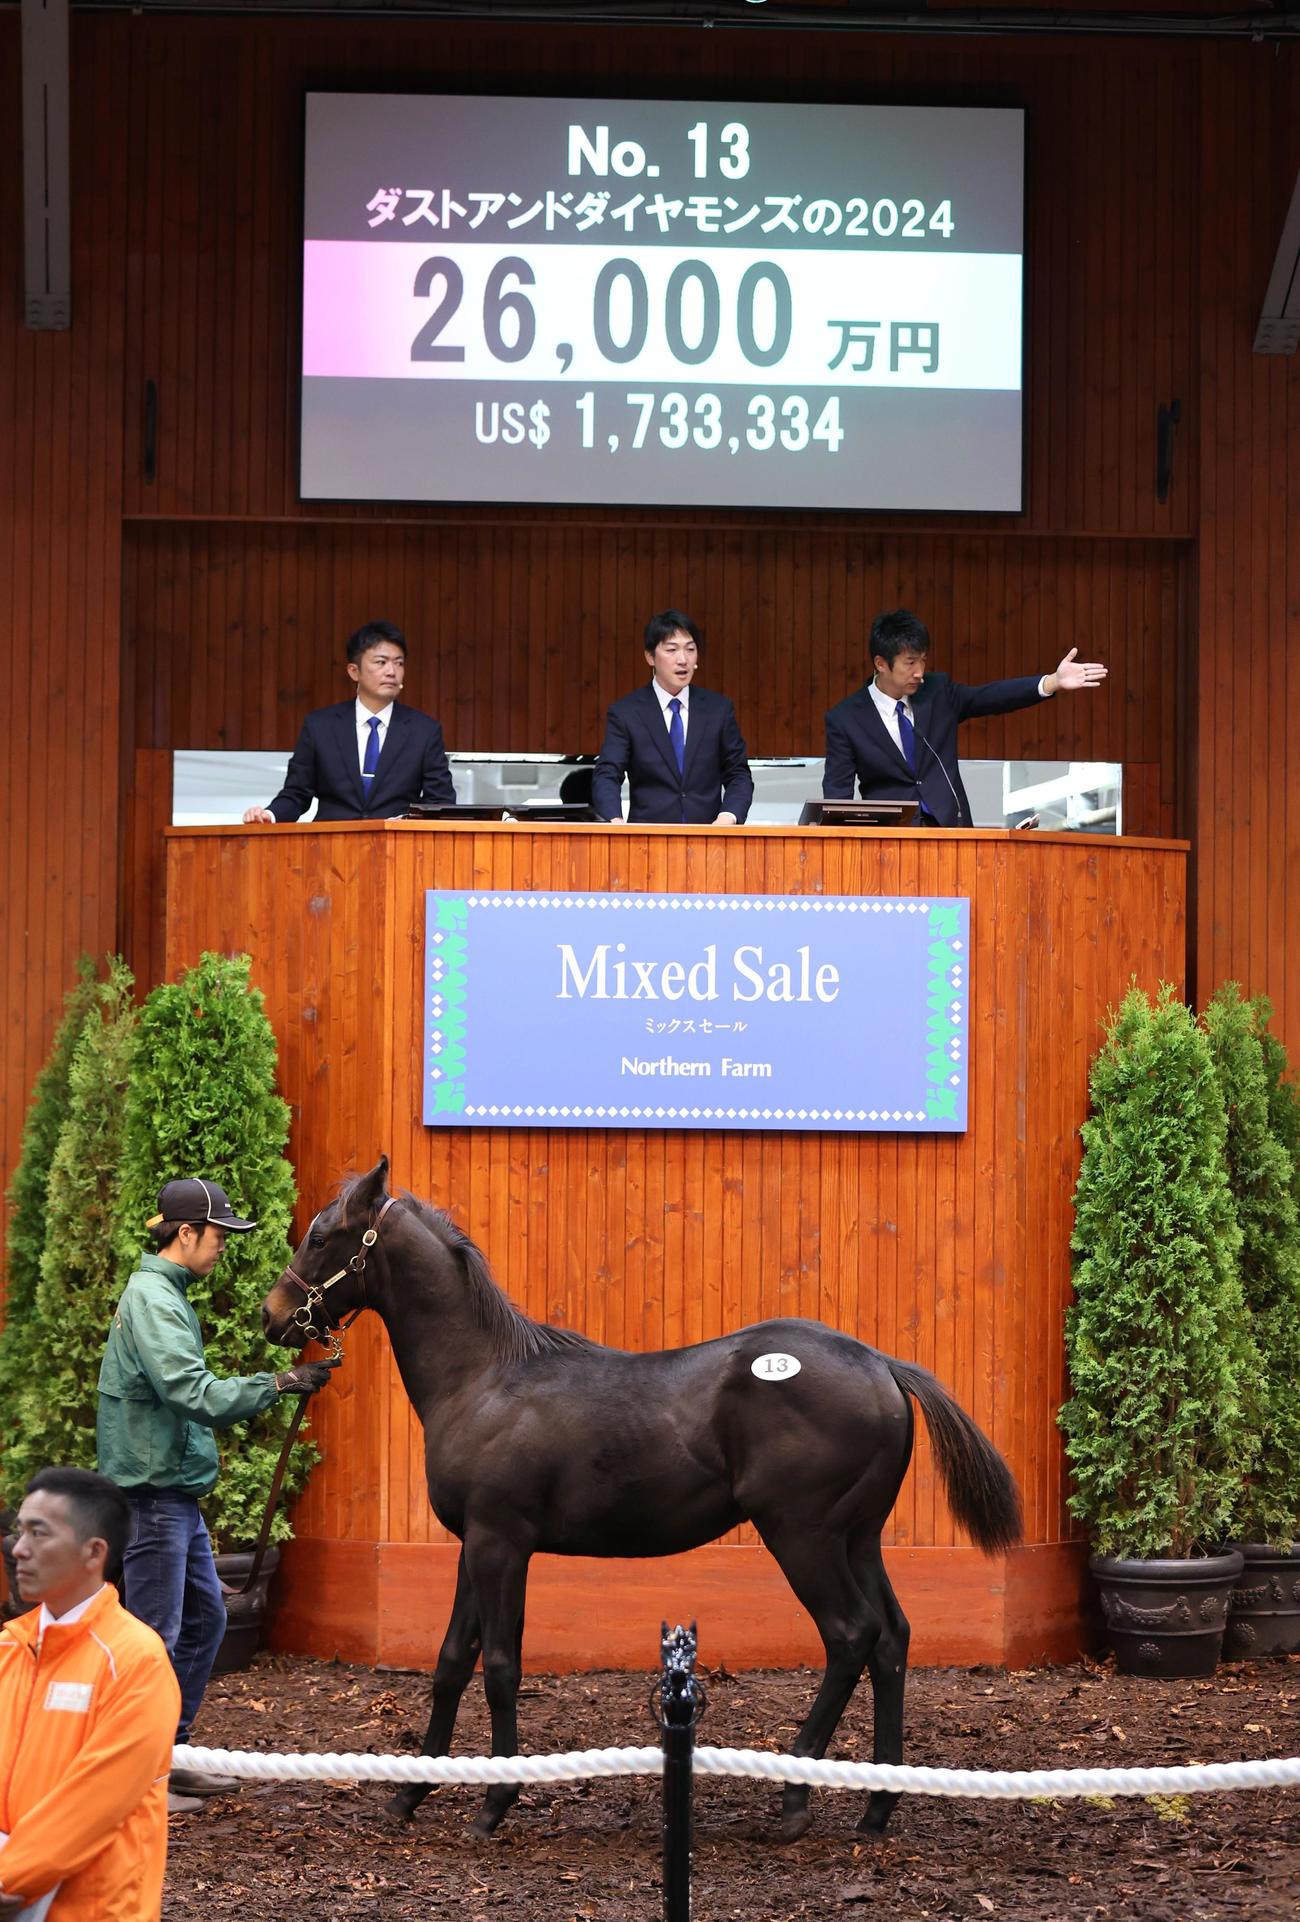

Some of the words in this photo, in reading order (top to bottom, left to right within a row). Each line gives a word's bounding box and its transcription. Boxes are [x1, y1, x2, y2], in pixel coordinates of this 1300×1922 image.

[567, 125, 660, 176] No.
[687, 122, 751, 178] 13
[366, 188, 955, 238] ダストアンドダイヤモンズの2024
[410, 256, 792, 374] 26,000
[826, 319, 941, 374] 万円
[474, 399, 550, 449] US$
[576, 392, 844, 454] 1,733,334
[556, 943, 719, 1001] Mixed
[732, 946, 840, 1003] Sale
[620, 1056, 711, 1077] Northern
[721, 1058, 772, 1078] Farm
[764, 1358, 788, 1373] 13
